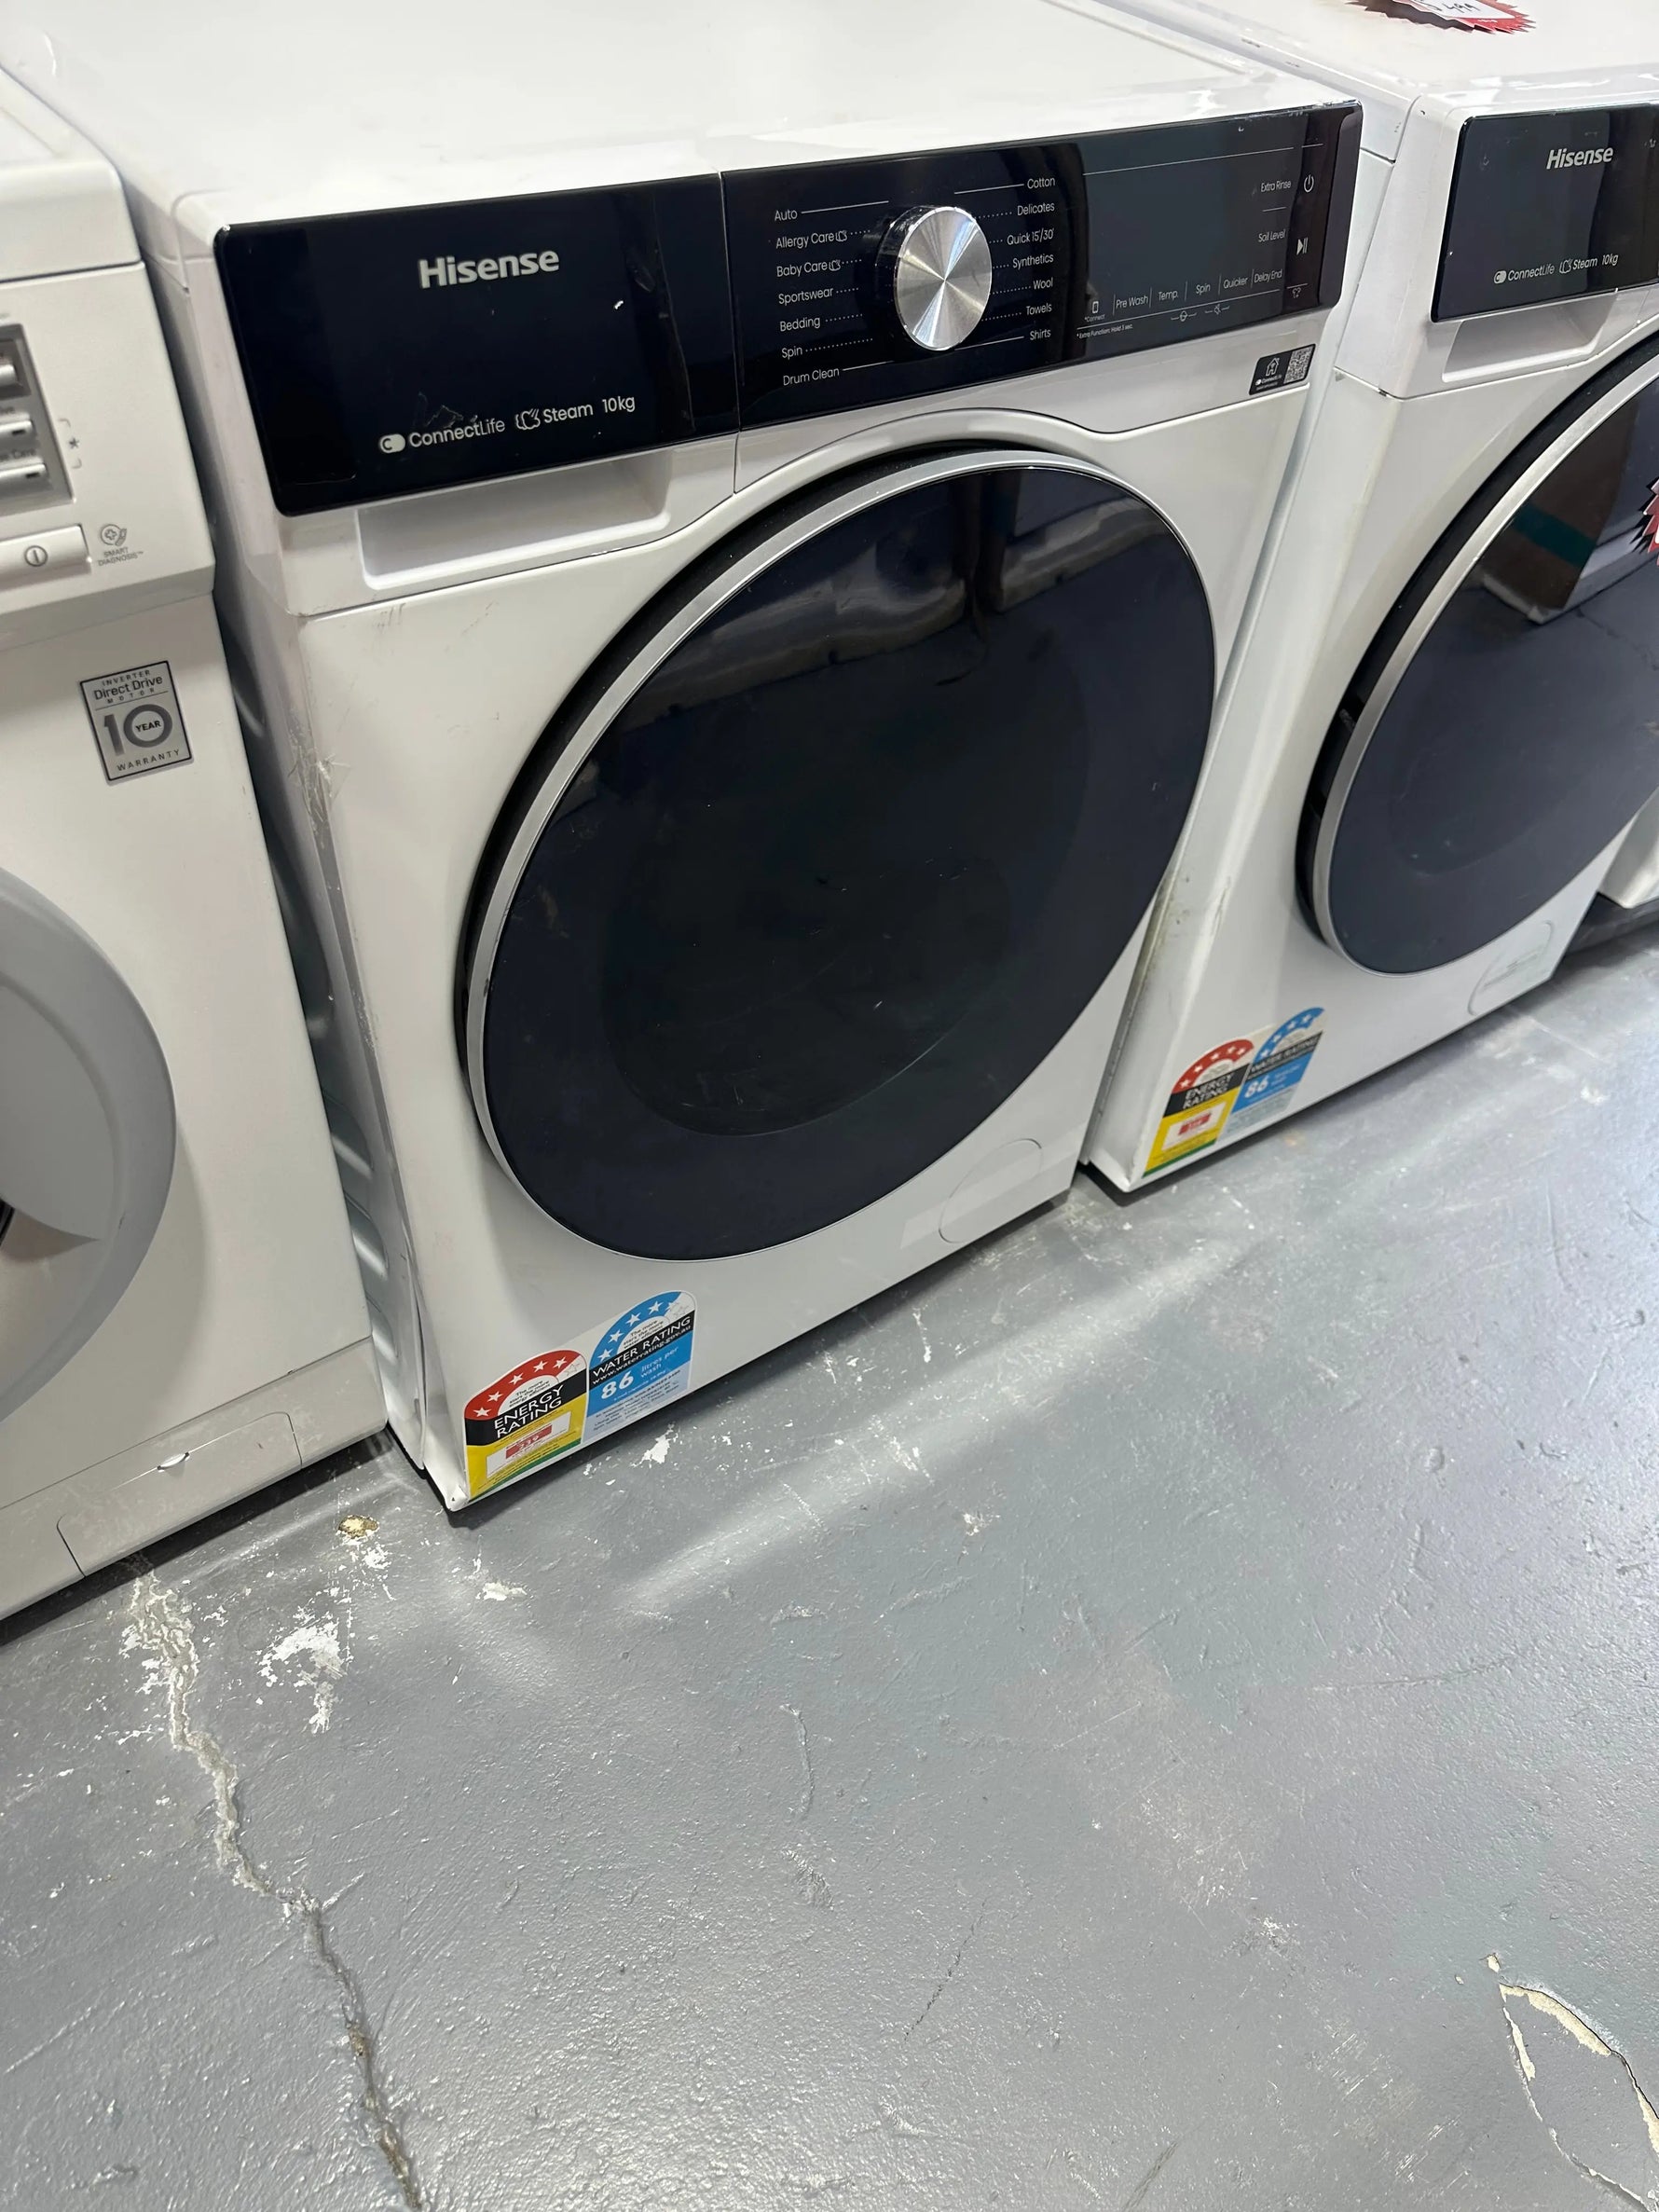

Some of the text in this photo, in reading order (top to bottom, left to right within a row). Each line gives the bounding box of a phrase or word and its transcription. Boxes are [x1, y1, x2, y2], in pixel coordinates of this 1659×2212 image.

[1546, 147, 1613, 170] Hisense
[1026, 177, 1055, 189] Cotton
[1260, 180, 1292, 192] Extra Rinse
[775, 210, 798, 222] Auto
[1017, 201, 1055, 216] Delicates
[775, 231, 835, 249] Allergy Care
[1007, 231, 1031, 245] Quick
[1258, 228, 1286, 242] Soil Level
[418, 250, 559, 289] Hisense
[776, 260, 828, 277] Baby Care
[1012, 254, 1054, 270] Synthetics
[1507, 254, 1619, 282] ConnectLife Steam 10kg
[1223, 276, 1249, 289] Quicker
[1254, 268, 1282, 283] Delay End
[1033, 278, 1053, 290] Wool
[1196, 283, 1211, 295] Spin
[778, 288, 834, 306] Sportswear
[1116, 295, 1148, 309] Pre Wash
[1026, 303, 1052, 316] Towels
[779, 317, 821, 332] Bedding
[1029, 328, 1051, 340] Shirts
[781, 346, 803, 360] Spin
[783, 368, 840, 386] Drum Clean
[409, 396, 636, 447] ConnectLife Steam 10kg
[103, 546, 129, 557] SMART
[102, 669, 151, 687] INVERTER
[94, 676, 163, 700] Direct Drive
[107, 687, 155, 704] MOTOR
[103, 704, 173, 757] 10
[136, 720, 161, 733] YEAR
[117, 749, 180, 771] WARRANTY
[1244, 1075, 1269, 1098] 86
[592, 1316, 691, 1377] WATER RATING
[664, 1347, 679, 1360] per
[601, 1370, 634, 1399] 86
[494, 1384, 564, 1430] ENERGY
[497, 1397, 562, 1438] RATING
